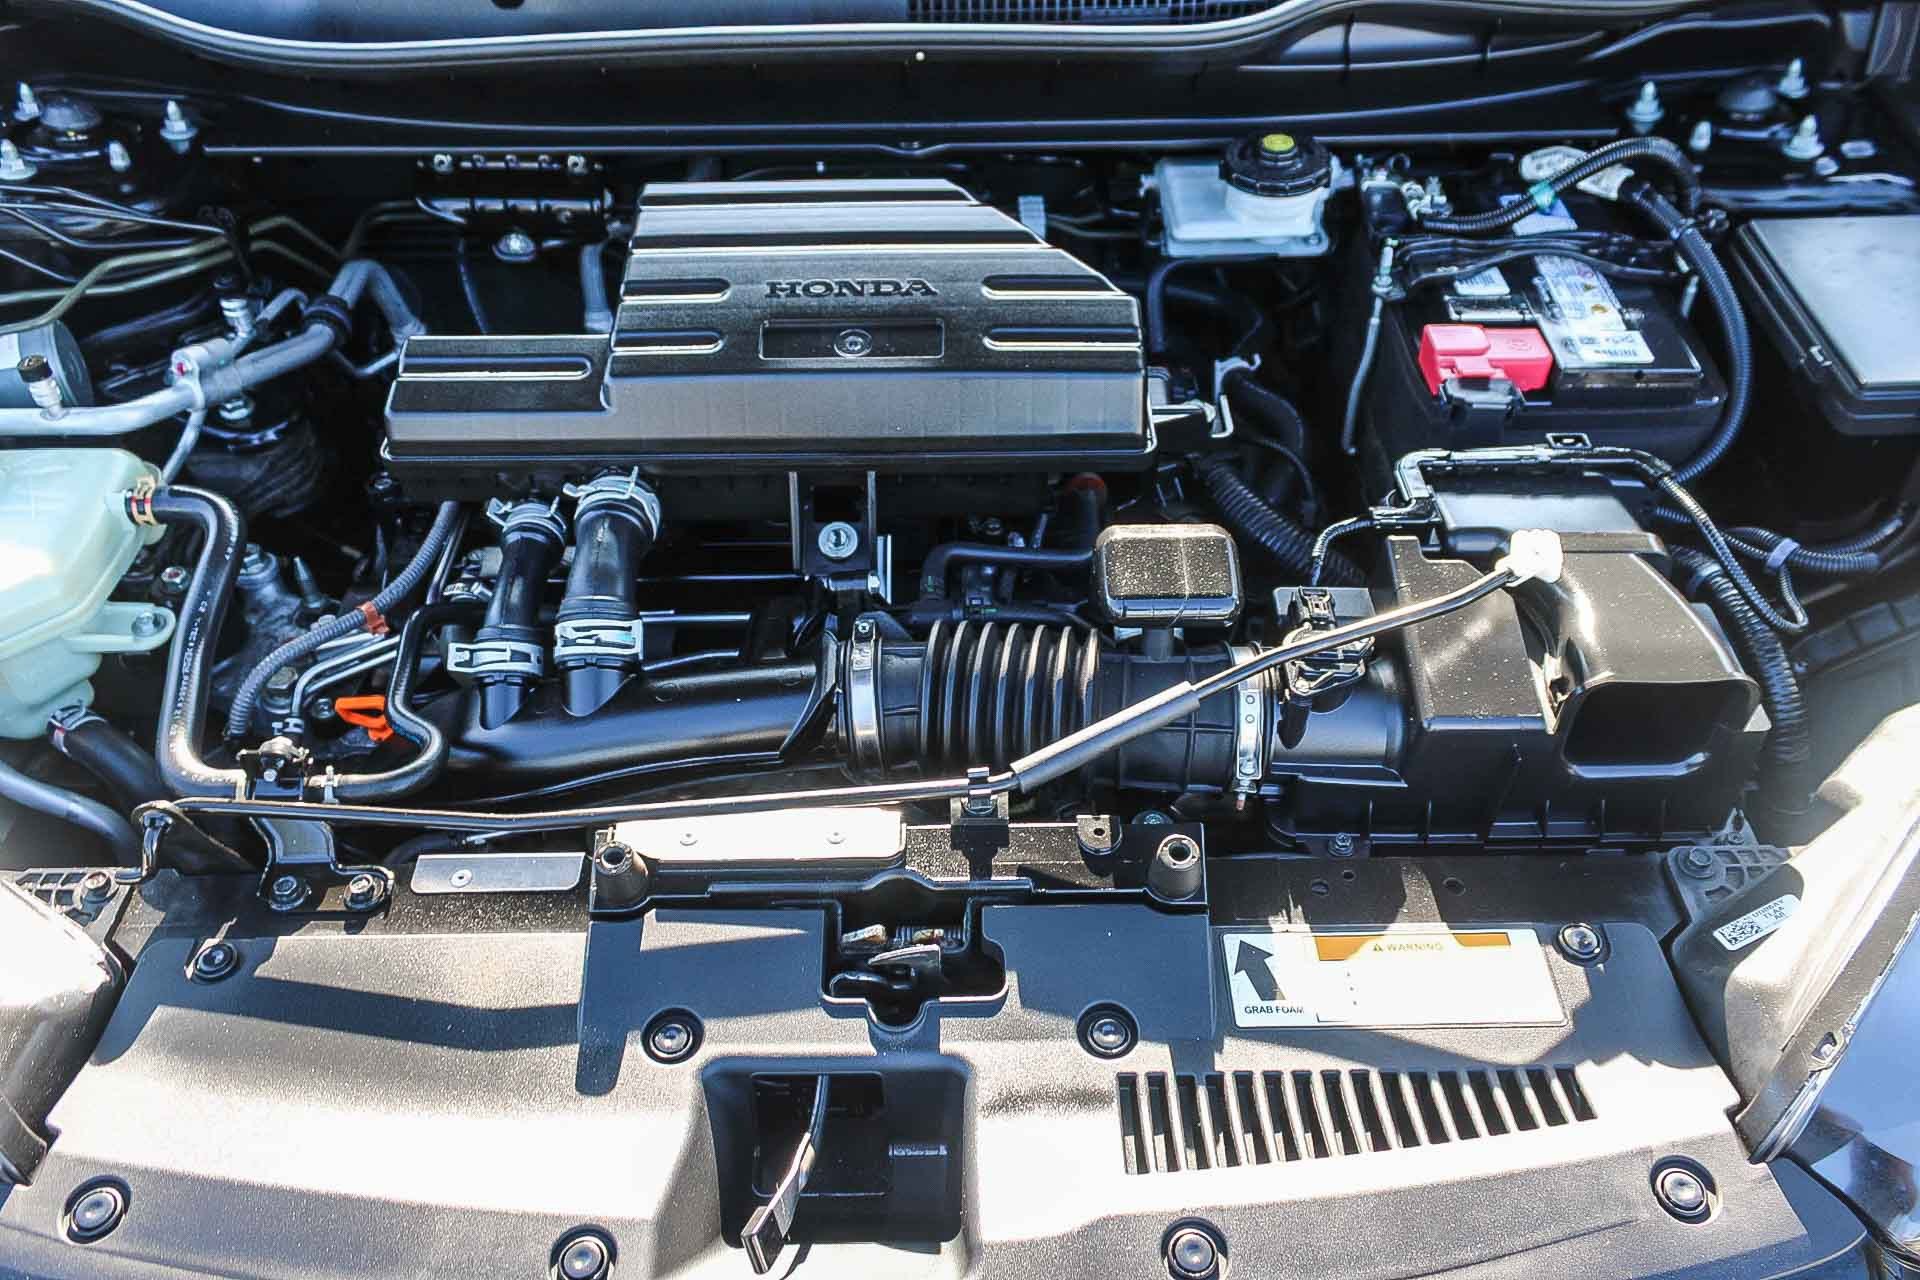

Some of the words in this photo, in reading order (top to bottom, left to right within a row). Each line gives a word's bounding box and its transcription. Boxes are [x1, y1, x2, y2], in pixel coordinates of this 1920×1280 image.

[764, 279, 939, 298] HONDA
[1387, 943, 1445, 952] WARNING
[1244, 1005, 1273, 1014] GRAB
